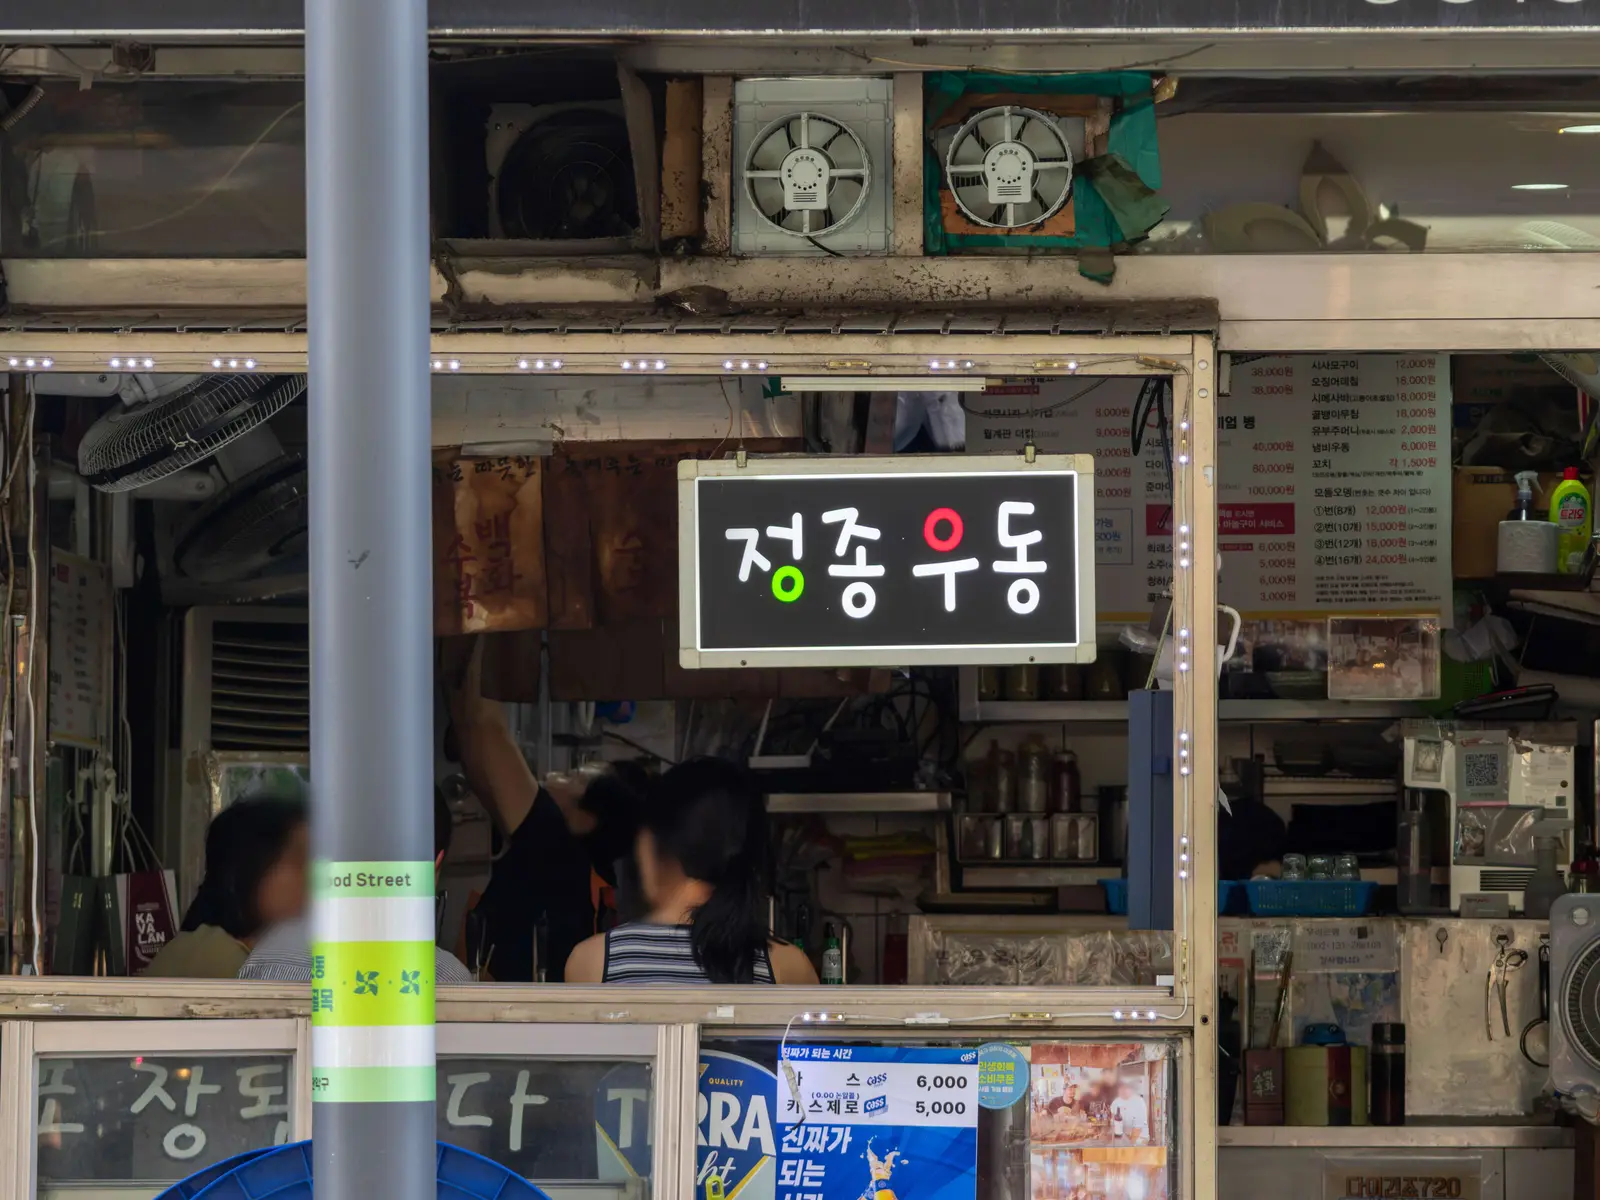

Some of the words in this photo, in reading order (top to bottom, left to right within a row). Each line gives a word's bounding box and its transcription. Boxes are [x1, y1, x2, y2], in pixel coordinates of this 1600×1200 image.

[1395, 358, 1436, 370] 12,000원
[1401, 424, 1437, 435] 2,000원
[725, 507, 886, 619] 정종
[912, 501, 1048, 615] 우동
[328, 873, 352, 887] od
[356, 872, 412, 887] Street
[135, 912, 155, 924] KA
[136, 922, 156, 934] VA
[137, 931, 166, 944] LAN
[811, 1048, 831, 1059] 되는
[833, 1048, 853, 1060] 시간
[708, 1077, 744, 1087] QUALITY
[917, 1075, 968, 1091] 6,000
[916, 1101, 966, 1117] 5,000
[781, 1125, 853, 1154] 진짜가
[778, 1159, 826, 1187] 되는
